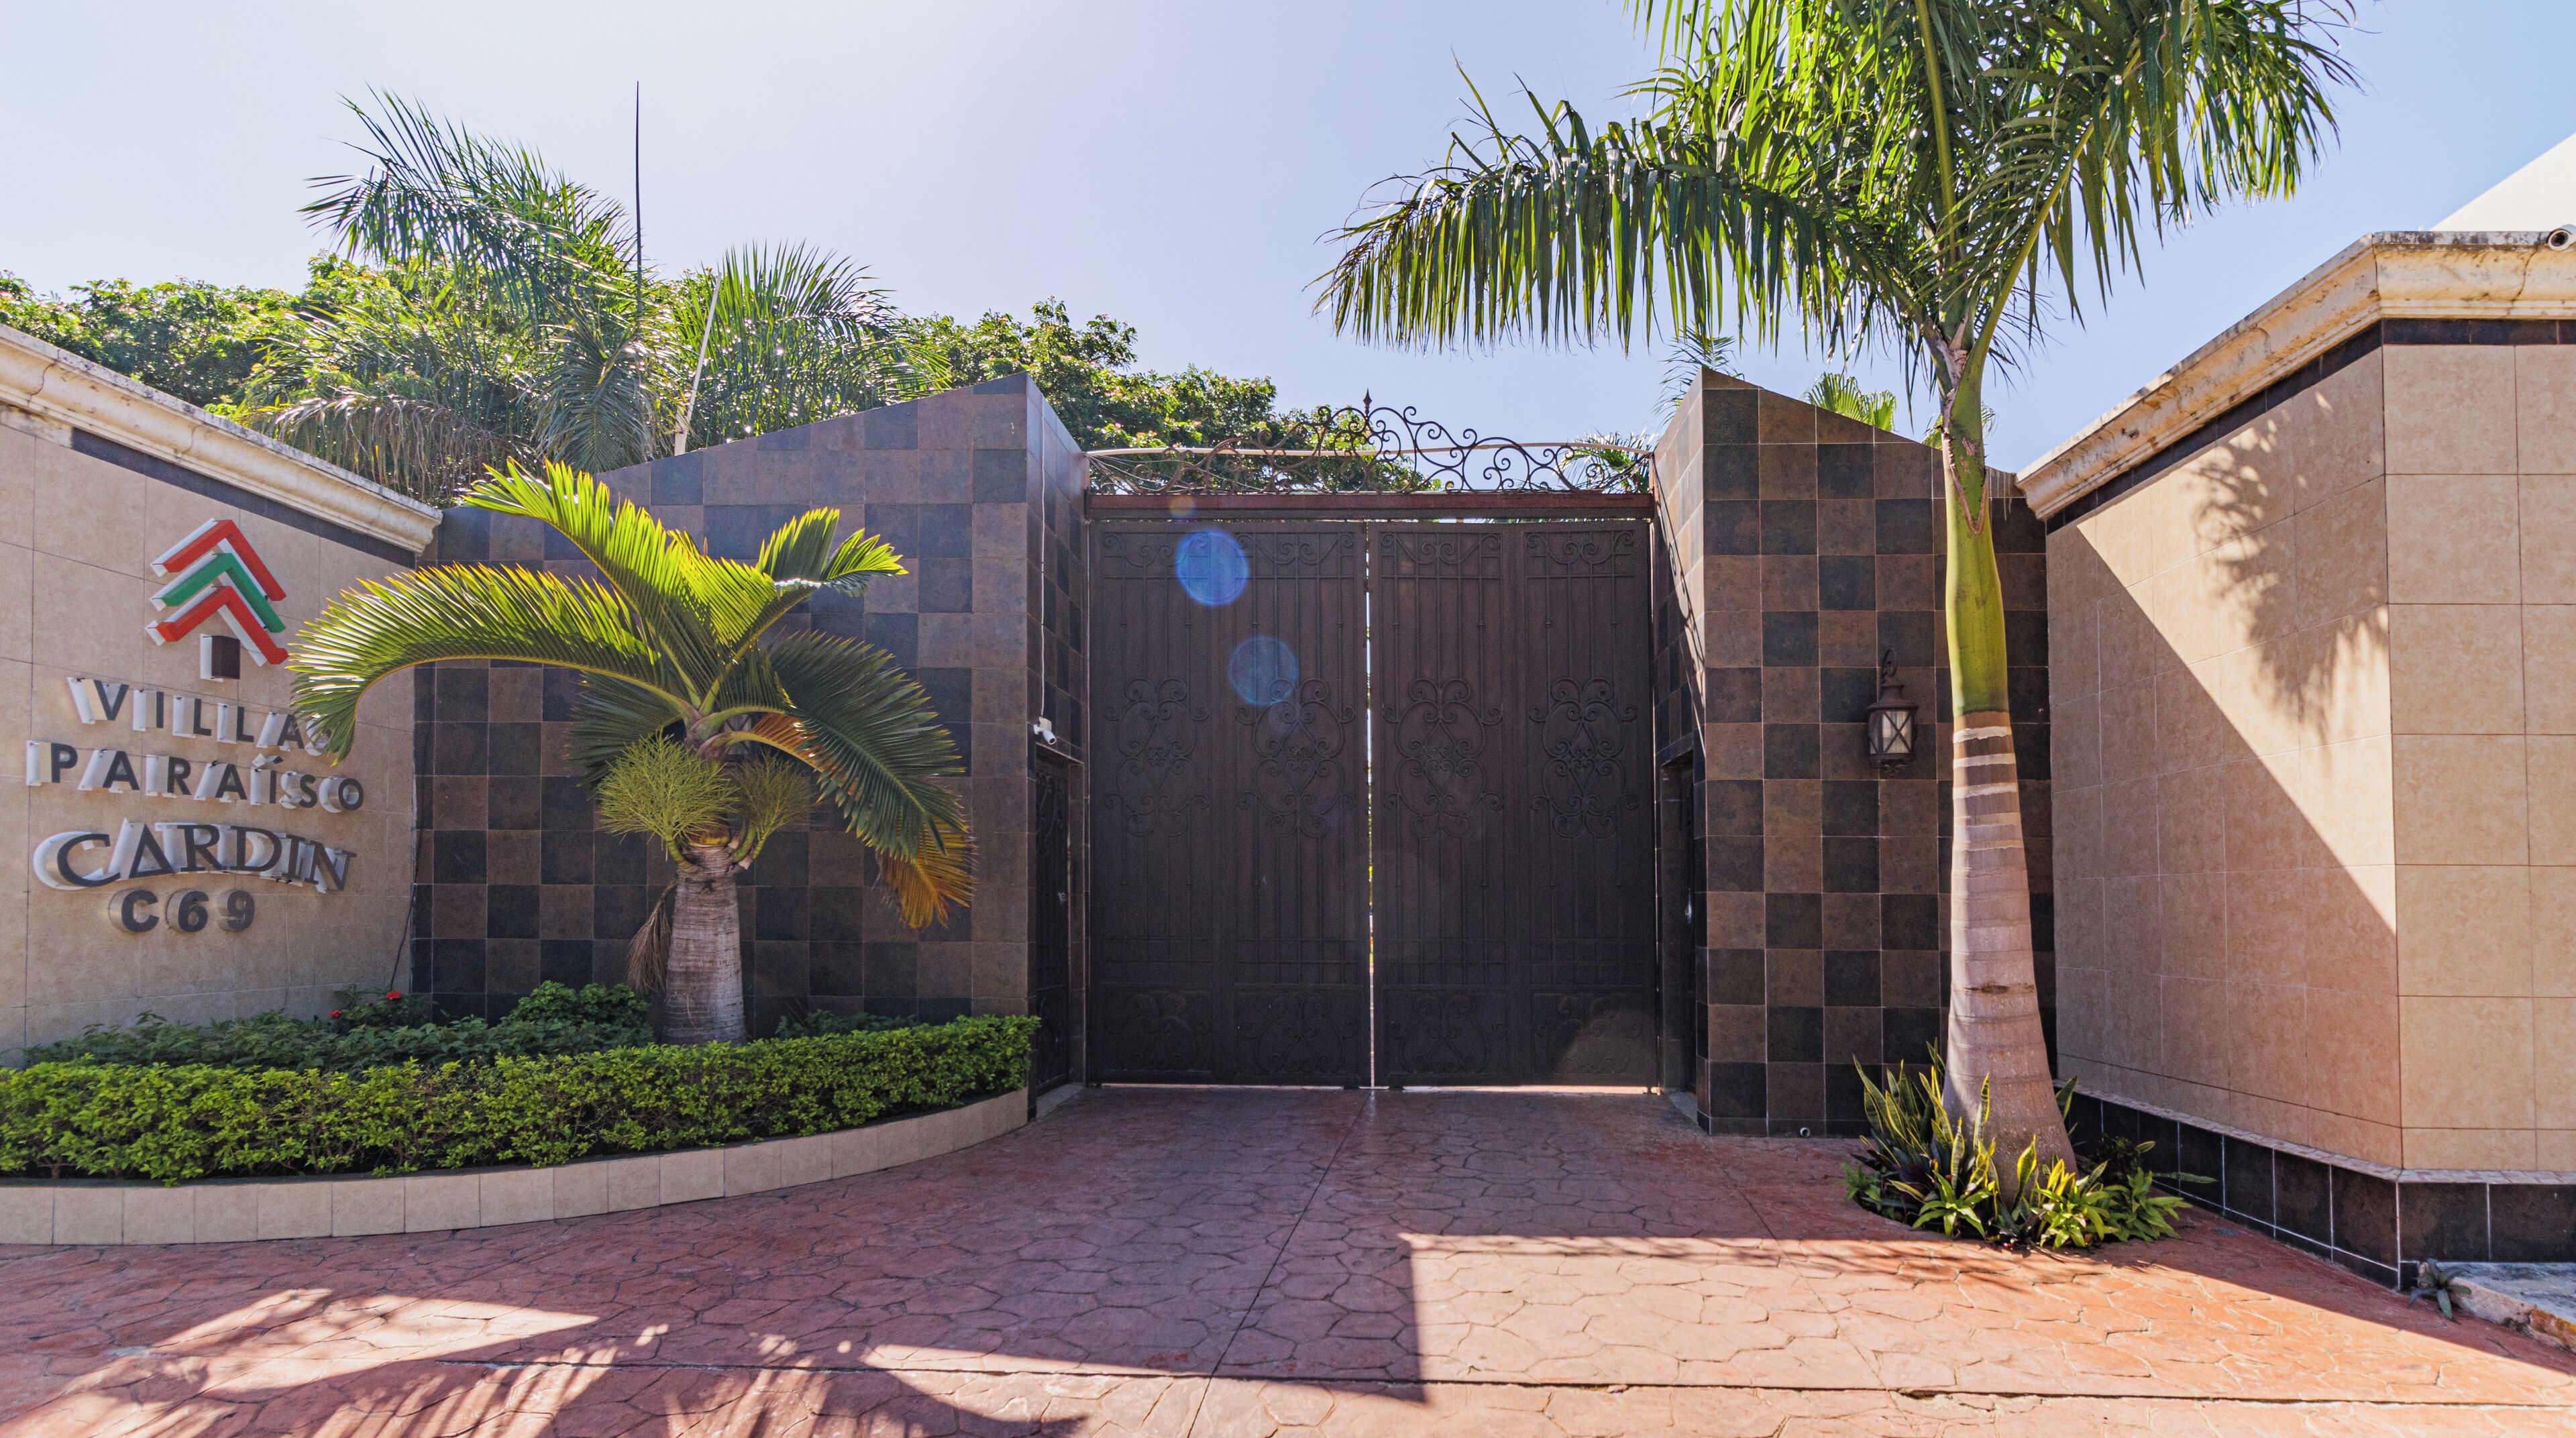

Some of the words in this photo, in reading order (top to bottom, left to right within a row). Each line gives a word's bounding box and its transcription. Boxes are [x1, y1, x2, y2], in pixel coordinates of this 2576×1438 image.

[26, 740, 364, 812] PARAÍSO
[34, 818, 356, 893] CARDIN
[108, 888, 255, 933] C69
